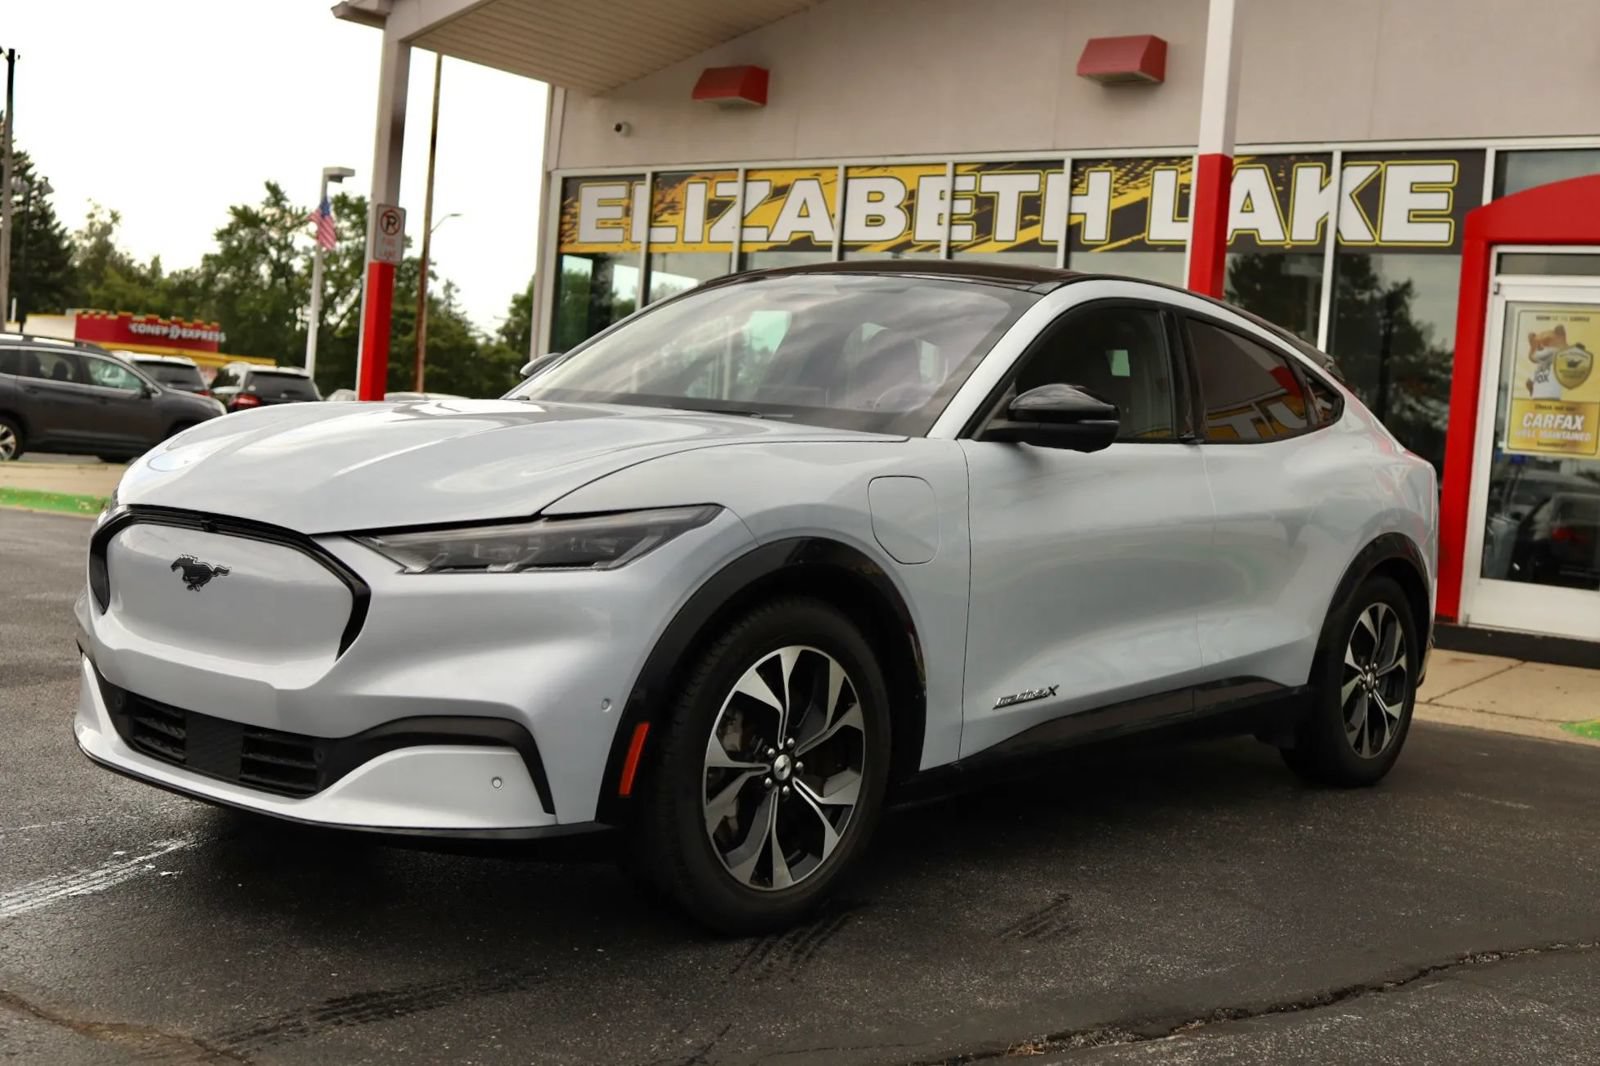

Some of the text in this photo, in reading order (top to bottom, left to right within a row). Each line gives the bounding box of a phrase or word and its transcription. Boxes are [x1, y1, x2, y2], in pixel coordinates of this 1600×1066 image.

[578, 161, 1459, 247] ELIZABETH LAKE
[129, 322, 227, 344] CONEY EXPRESS
[1522, 411, 1585, 431] CARFAX
